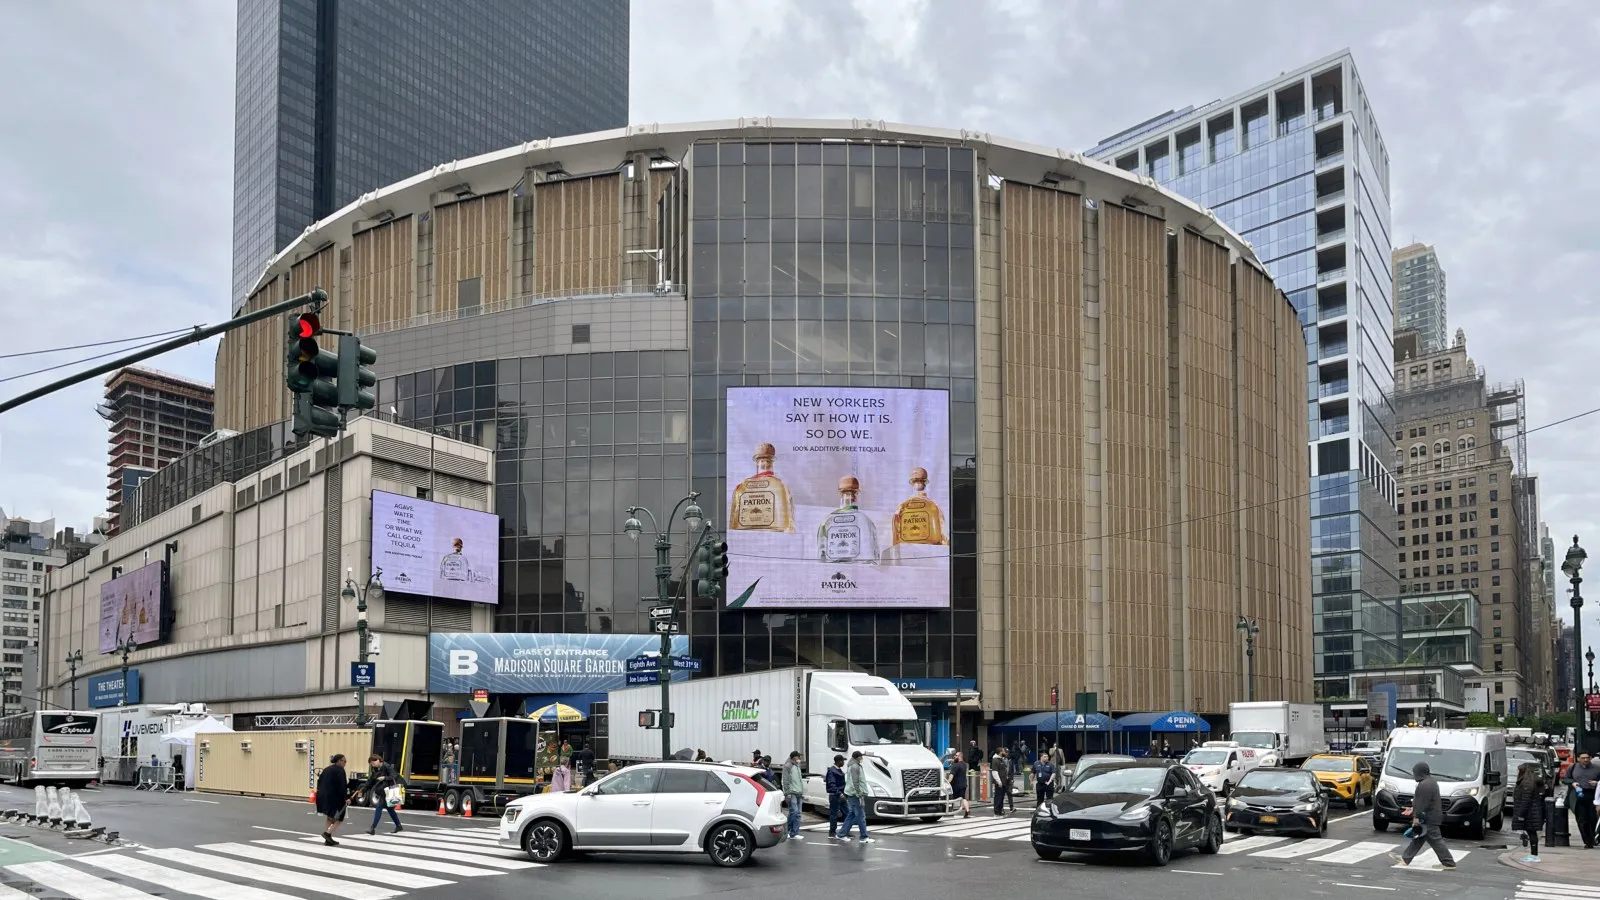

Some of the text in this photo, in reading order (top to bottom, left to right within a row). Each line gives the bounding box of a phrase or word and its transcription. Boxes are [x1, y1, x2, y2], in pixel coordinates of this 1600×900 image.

[793, 398, 884, 408] NEW YORKERS
[786, 414, 892, 424] SAY IT HOW IT IS.
[806, 430, 872, 439] SO DO WE.
[391, 540, 416, 549] TEQUILA
[821, 579, 858, 589] PATRÓN
[450, 650, 478, 676] B
[494, 658, 624, 673] MADISON SQUARE GARDEN
[629, 661, 645, 669] Eighth
[98, 682, 106, 691] THE
[722, 699, 759, 720] GRMEC
[1075, 714, 1085, 723] A
[132, 724, 164, 734] LIVEMEDIA
